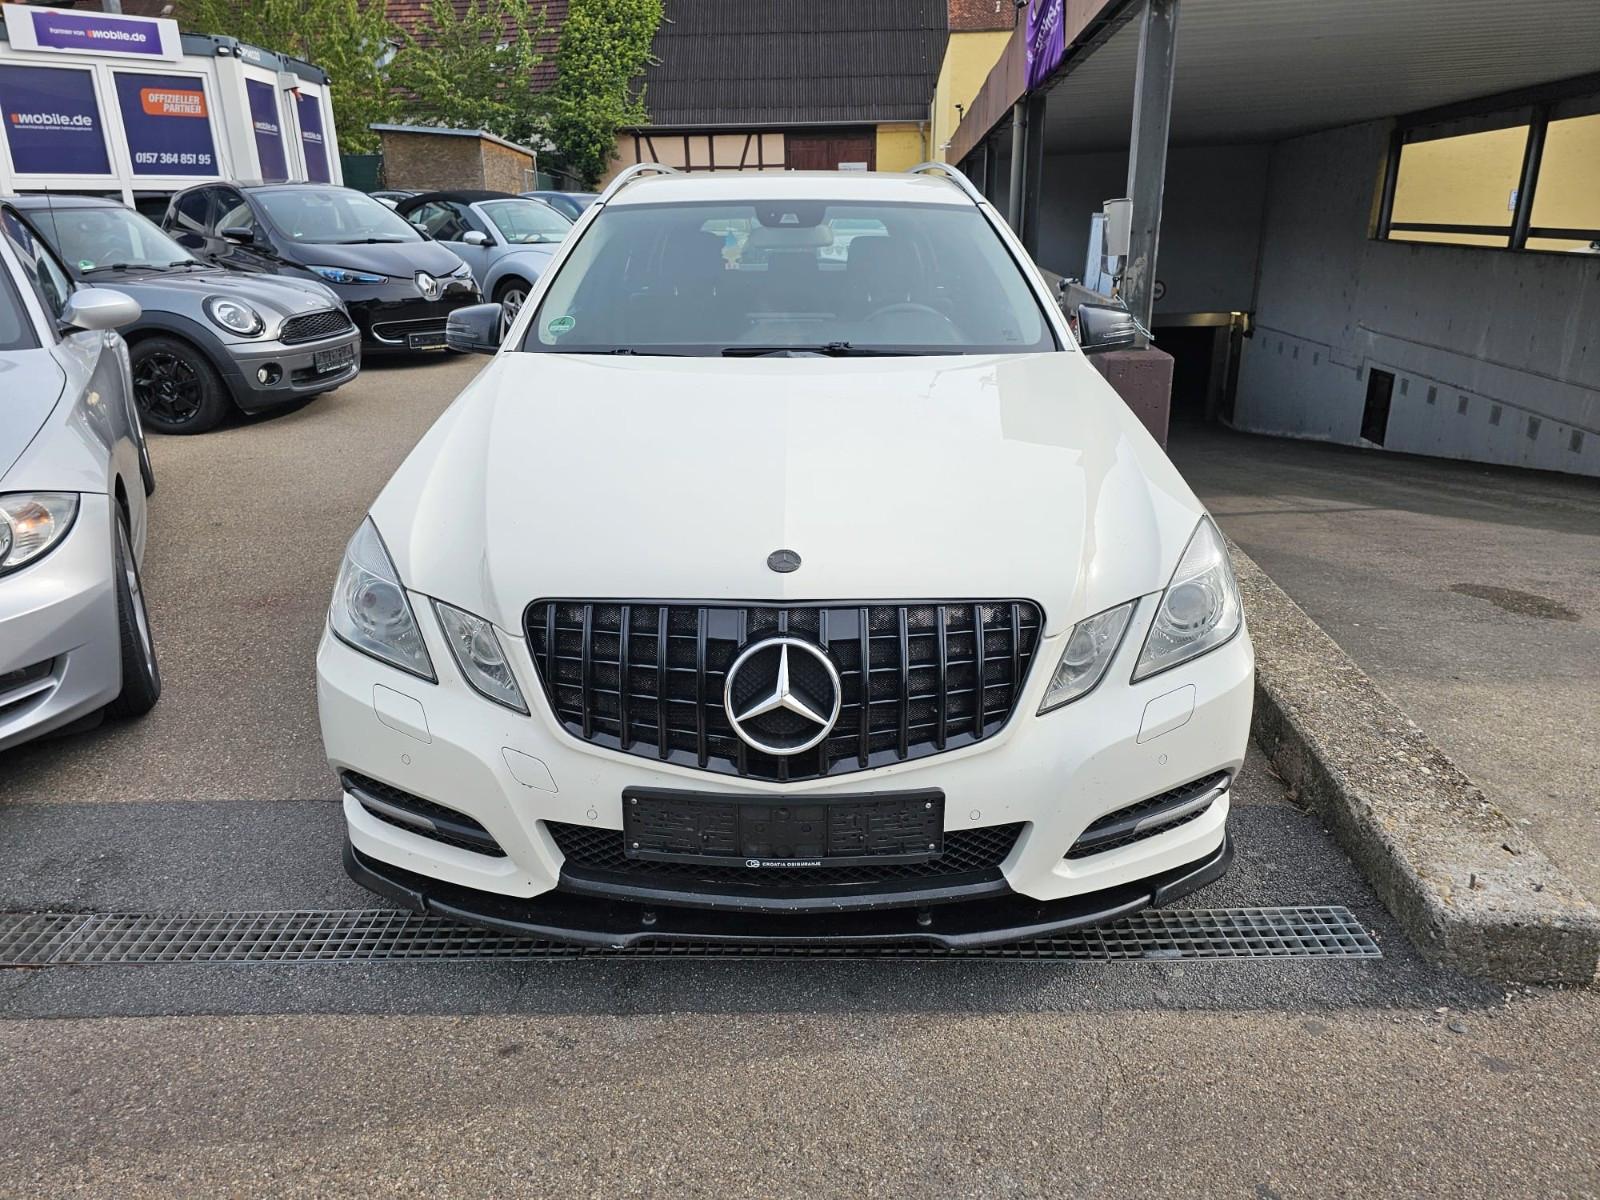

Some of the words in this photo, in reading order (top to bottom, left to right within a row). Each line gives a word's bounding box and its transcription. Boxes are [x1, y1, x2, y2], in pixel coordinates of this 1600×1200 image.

[87, 29, 147, 42] mobile.de
[148, 93, 200, 104] OFFIZIELLER
[163, 104, 201, 113] PARTNER
[11, 112, 93, 126] mobile.de
[135, 152, 159, 164] 0157
[160, 152, 179, 164] 364
[180, 153, 197, 165] 851
[198, 153, 212, 165] 95
